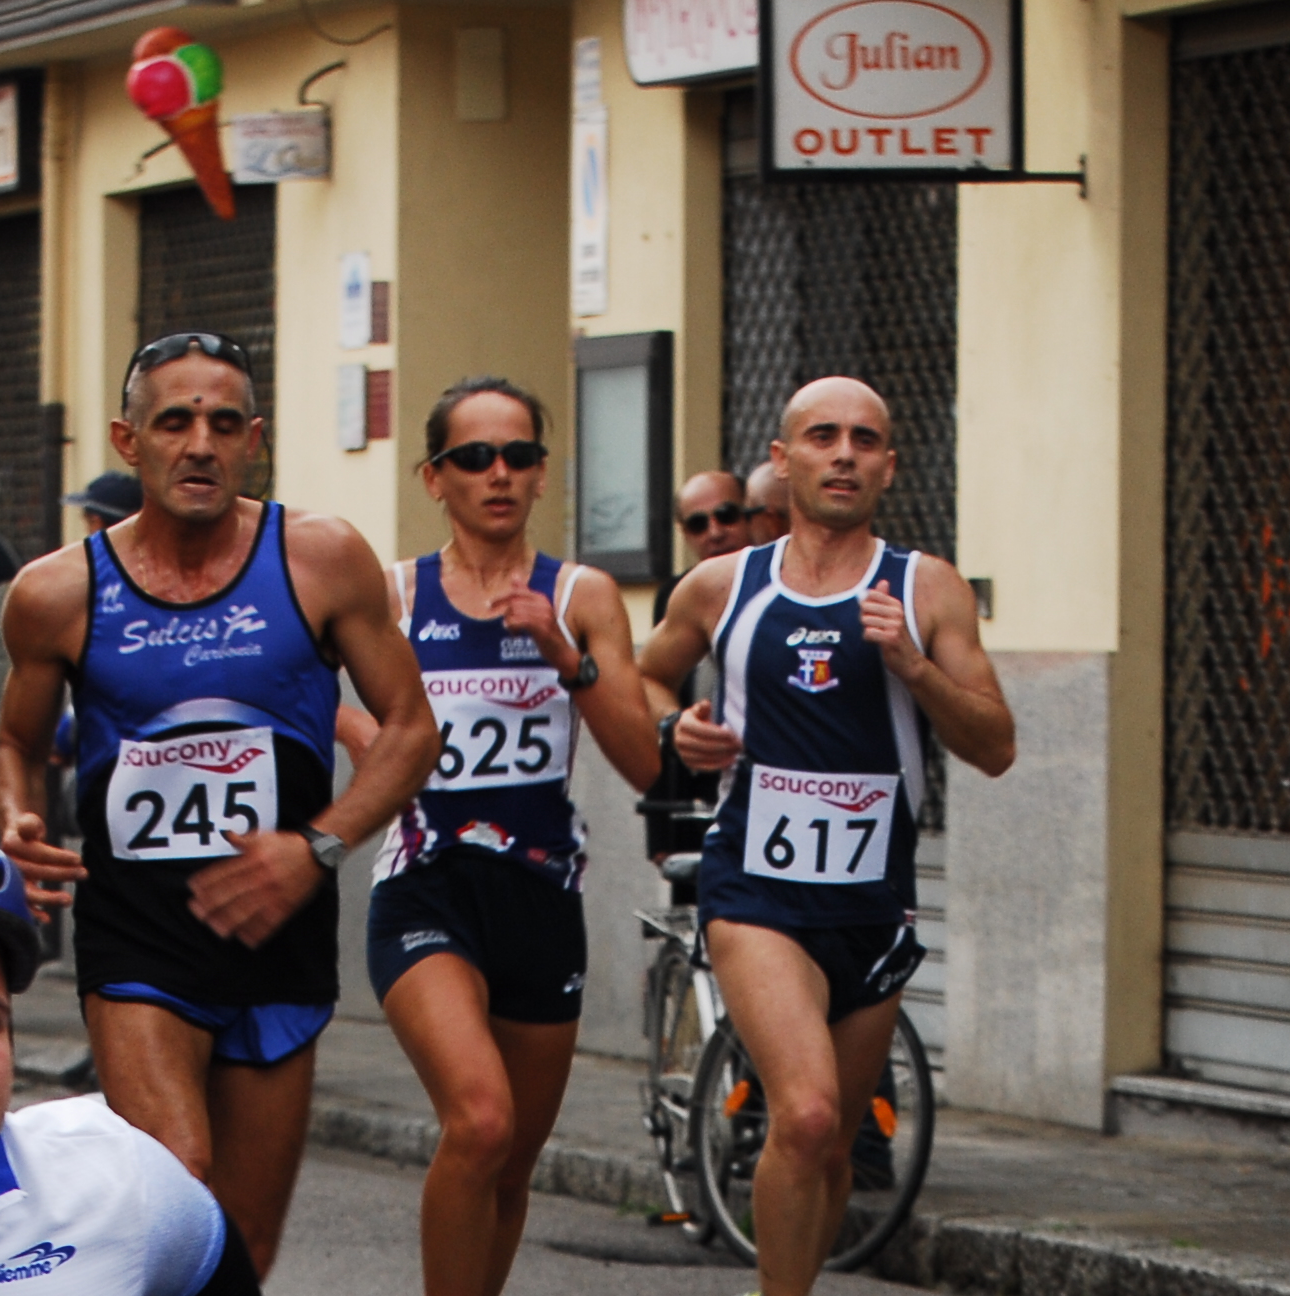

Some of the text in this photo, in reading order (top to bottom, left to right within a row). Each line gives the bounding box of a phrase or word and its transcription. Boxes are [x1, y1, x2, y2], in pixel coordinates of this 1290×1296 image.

[819, 31, 961, 90] Julian
[793, 127, 993, 156] OUTLET
[118, 616, 219, 654] Sulcis
[438, 716, 552, 780] 625
[125, 780, 260, 851] 245
[758, 772, 863, 801] saucony
[763, 814, 878, 875] 617
